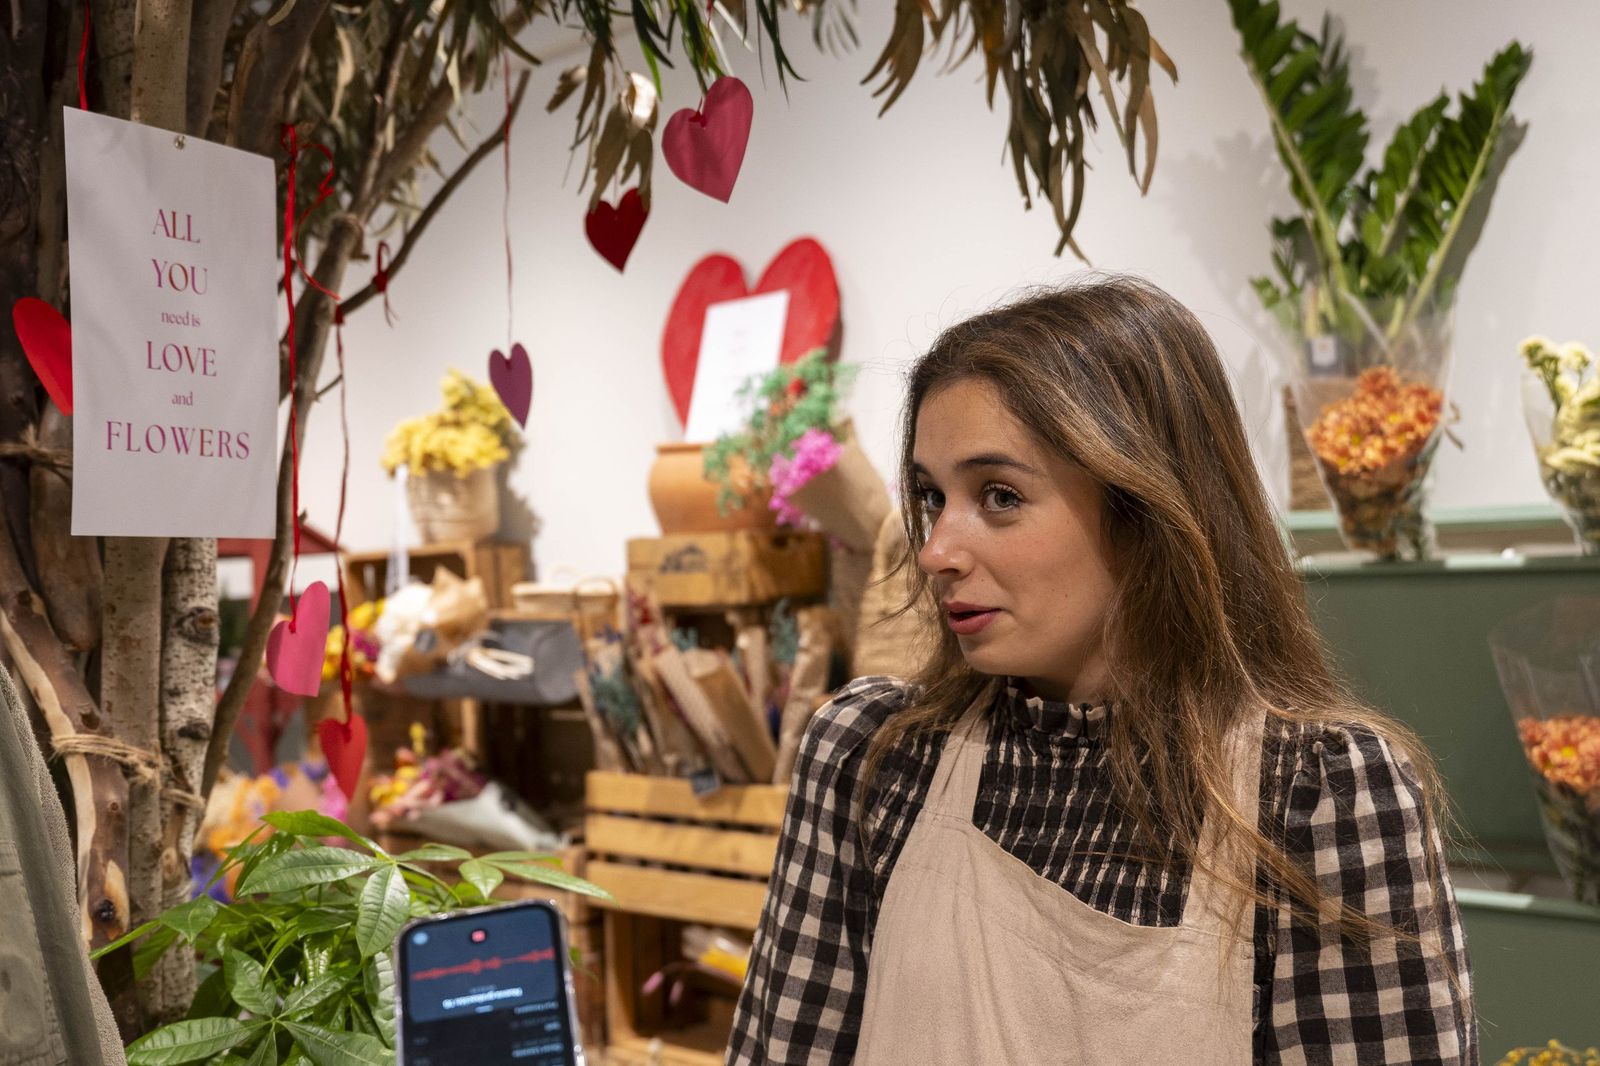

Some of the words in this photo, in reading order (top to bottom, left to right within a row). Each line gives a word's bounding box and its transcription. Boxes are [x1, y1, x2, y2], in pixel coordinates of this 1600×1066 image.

[152, 208, 201, 244] ALL
[151, 258, 208, 295] YOU
[161, 311, 190, 326] need
[191, 312, 201, 328] is
[146, 341, 217, 377] LOVE
[171, 391, 193, 407] and
[106, 420, 250, 460] FLOWERS
